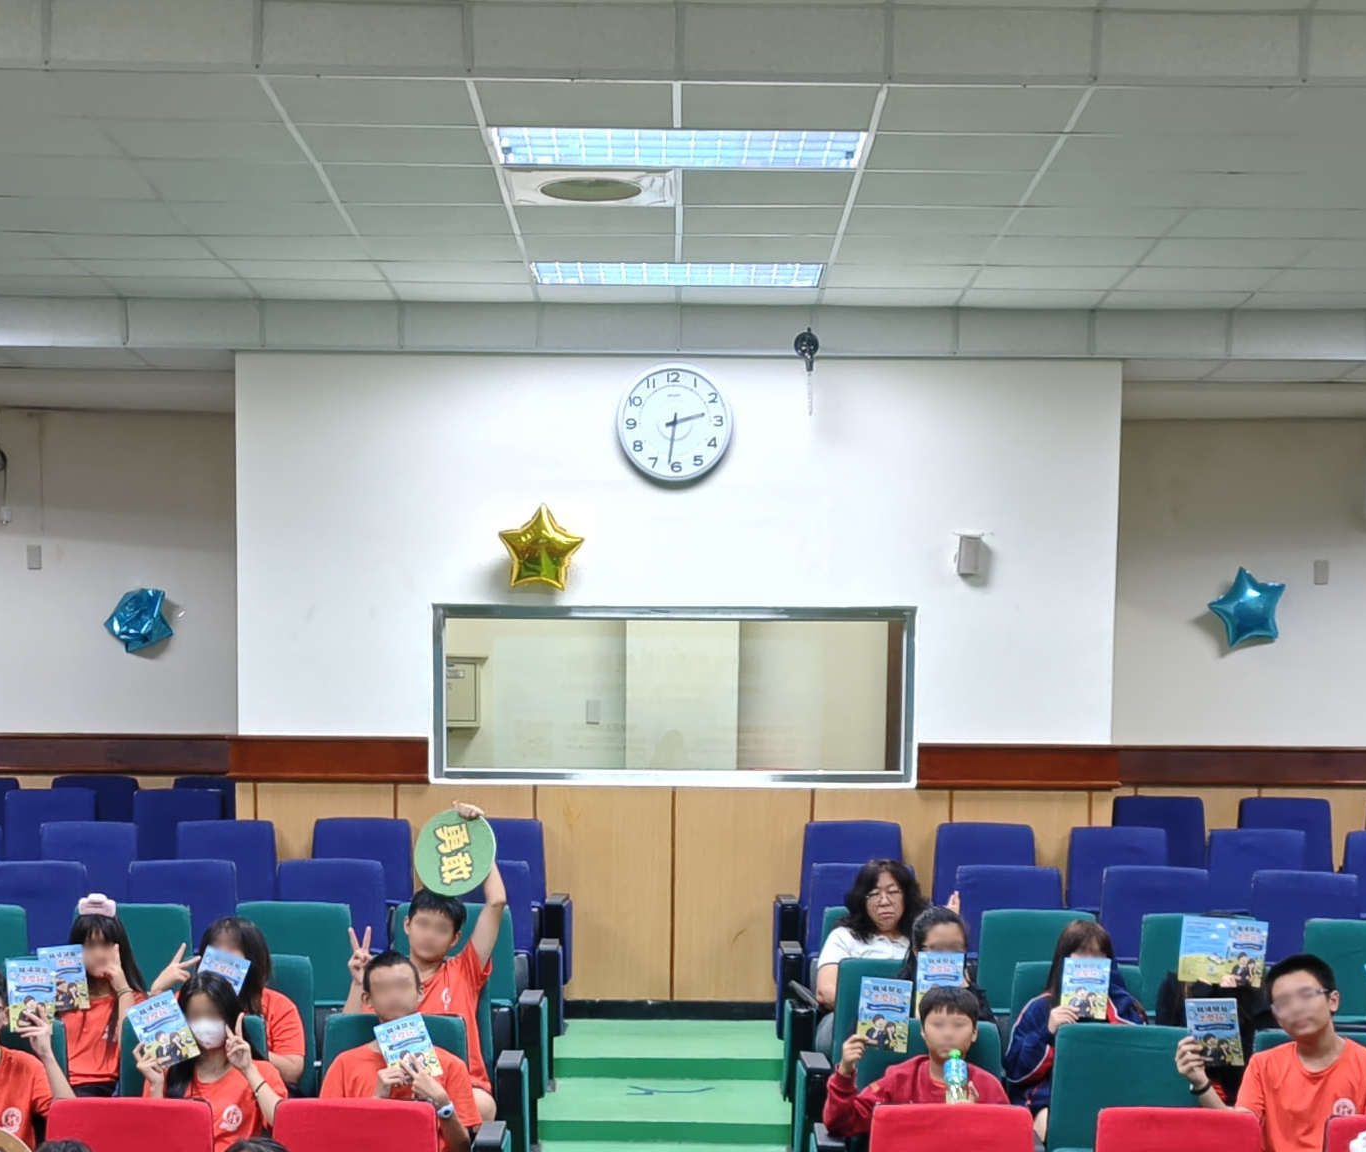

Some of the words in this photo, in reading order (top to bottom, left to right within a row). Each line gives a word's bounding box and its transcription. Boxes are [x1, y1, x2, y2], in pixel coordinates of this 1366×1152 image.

[667, 372, 680, 383] 12
[647, 378, 655, 389] 11
[629, 396, 642, 407] 10
[708, 392, 718, 403] 2
[625, 418, 637, 429] 9
[713, 415, 723, 426] 3
[633, 440, 643, 452] 8
[707, 437, 717, 448] 4
[648, 457, 658, 468] 7
[693, 455, 703, 466] 5
[671, 462, 682, 473] 6
[435, 823, 473, 884] 勇敢
